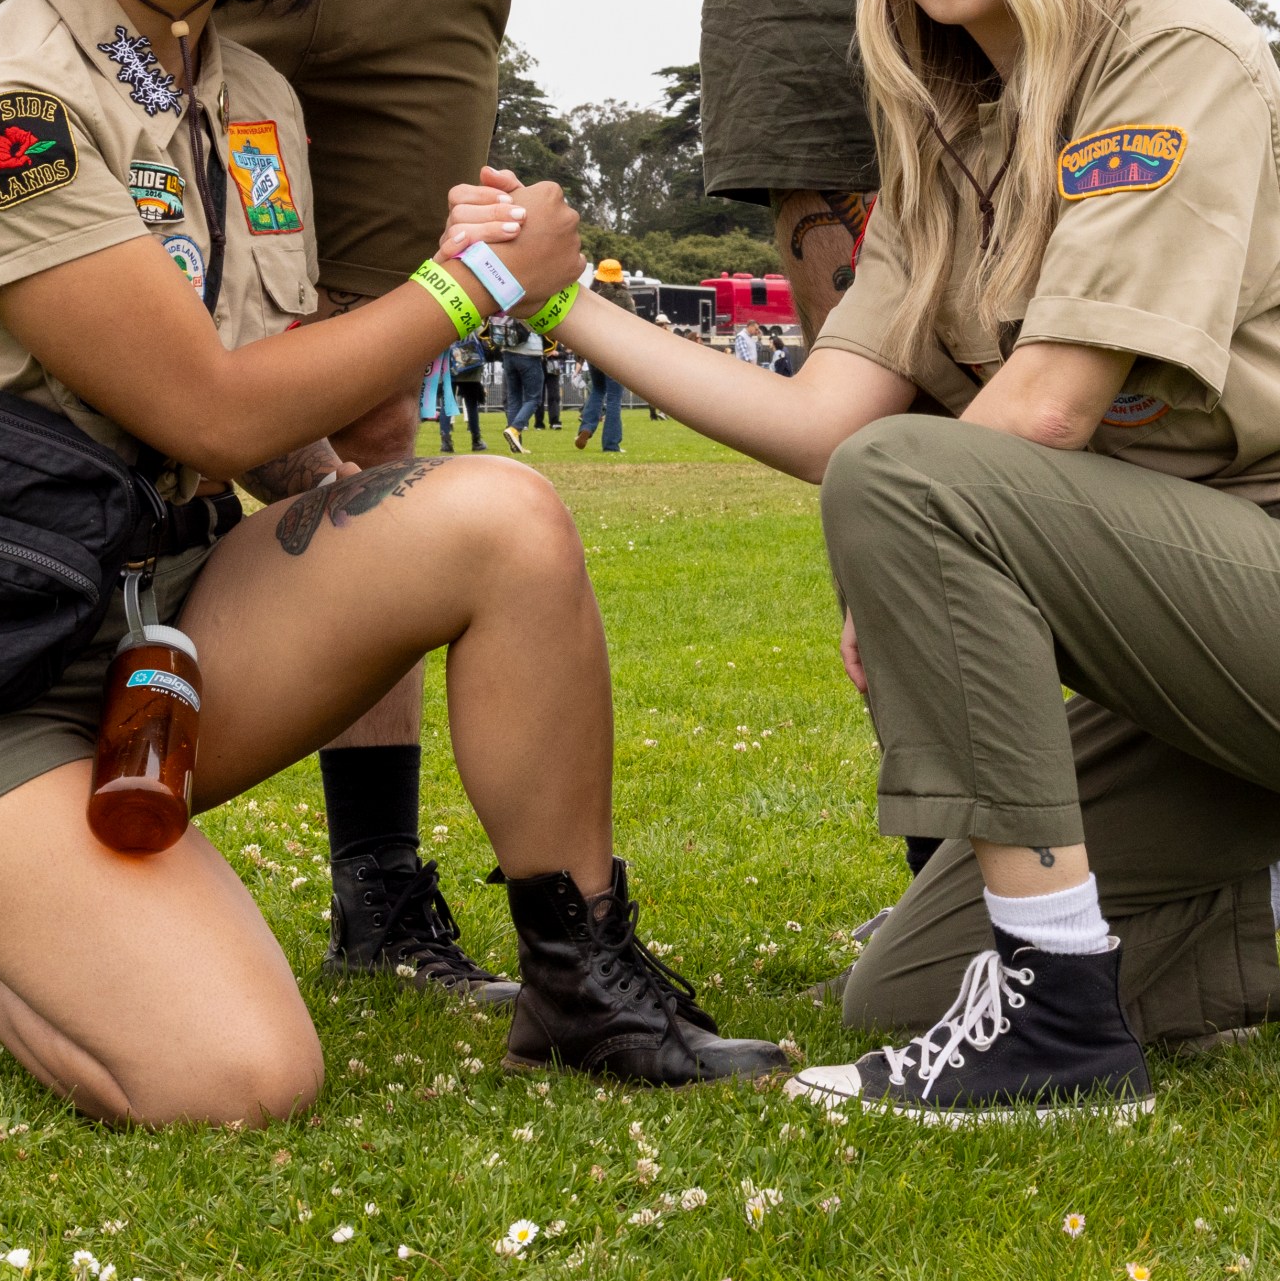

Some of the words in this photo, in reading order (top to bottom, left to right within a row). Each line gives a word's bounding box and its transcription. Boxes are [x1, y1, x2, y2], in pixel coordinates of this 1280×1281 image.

[237, 126, 273, 135] ANNIVERSARY
[1062, 135, 1121, 173] OUTSIDE
[1122, 131, 1180, 160] LANDS
[238, 155, 273, 168] OUTSIDE
[145, 190, 162, 198] 2016
[253, 174, 274, 201] LANDS
[182, 245, 199, 272] LANDS
[416, 266, 455, 296] CARDÍ
[449, 296, 462, 312] 21+
[1111, 405, 1126, 414] AN
[153, 674, 199, 704] nalgene
[178, 696, 189, 706] USA
